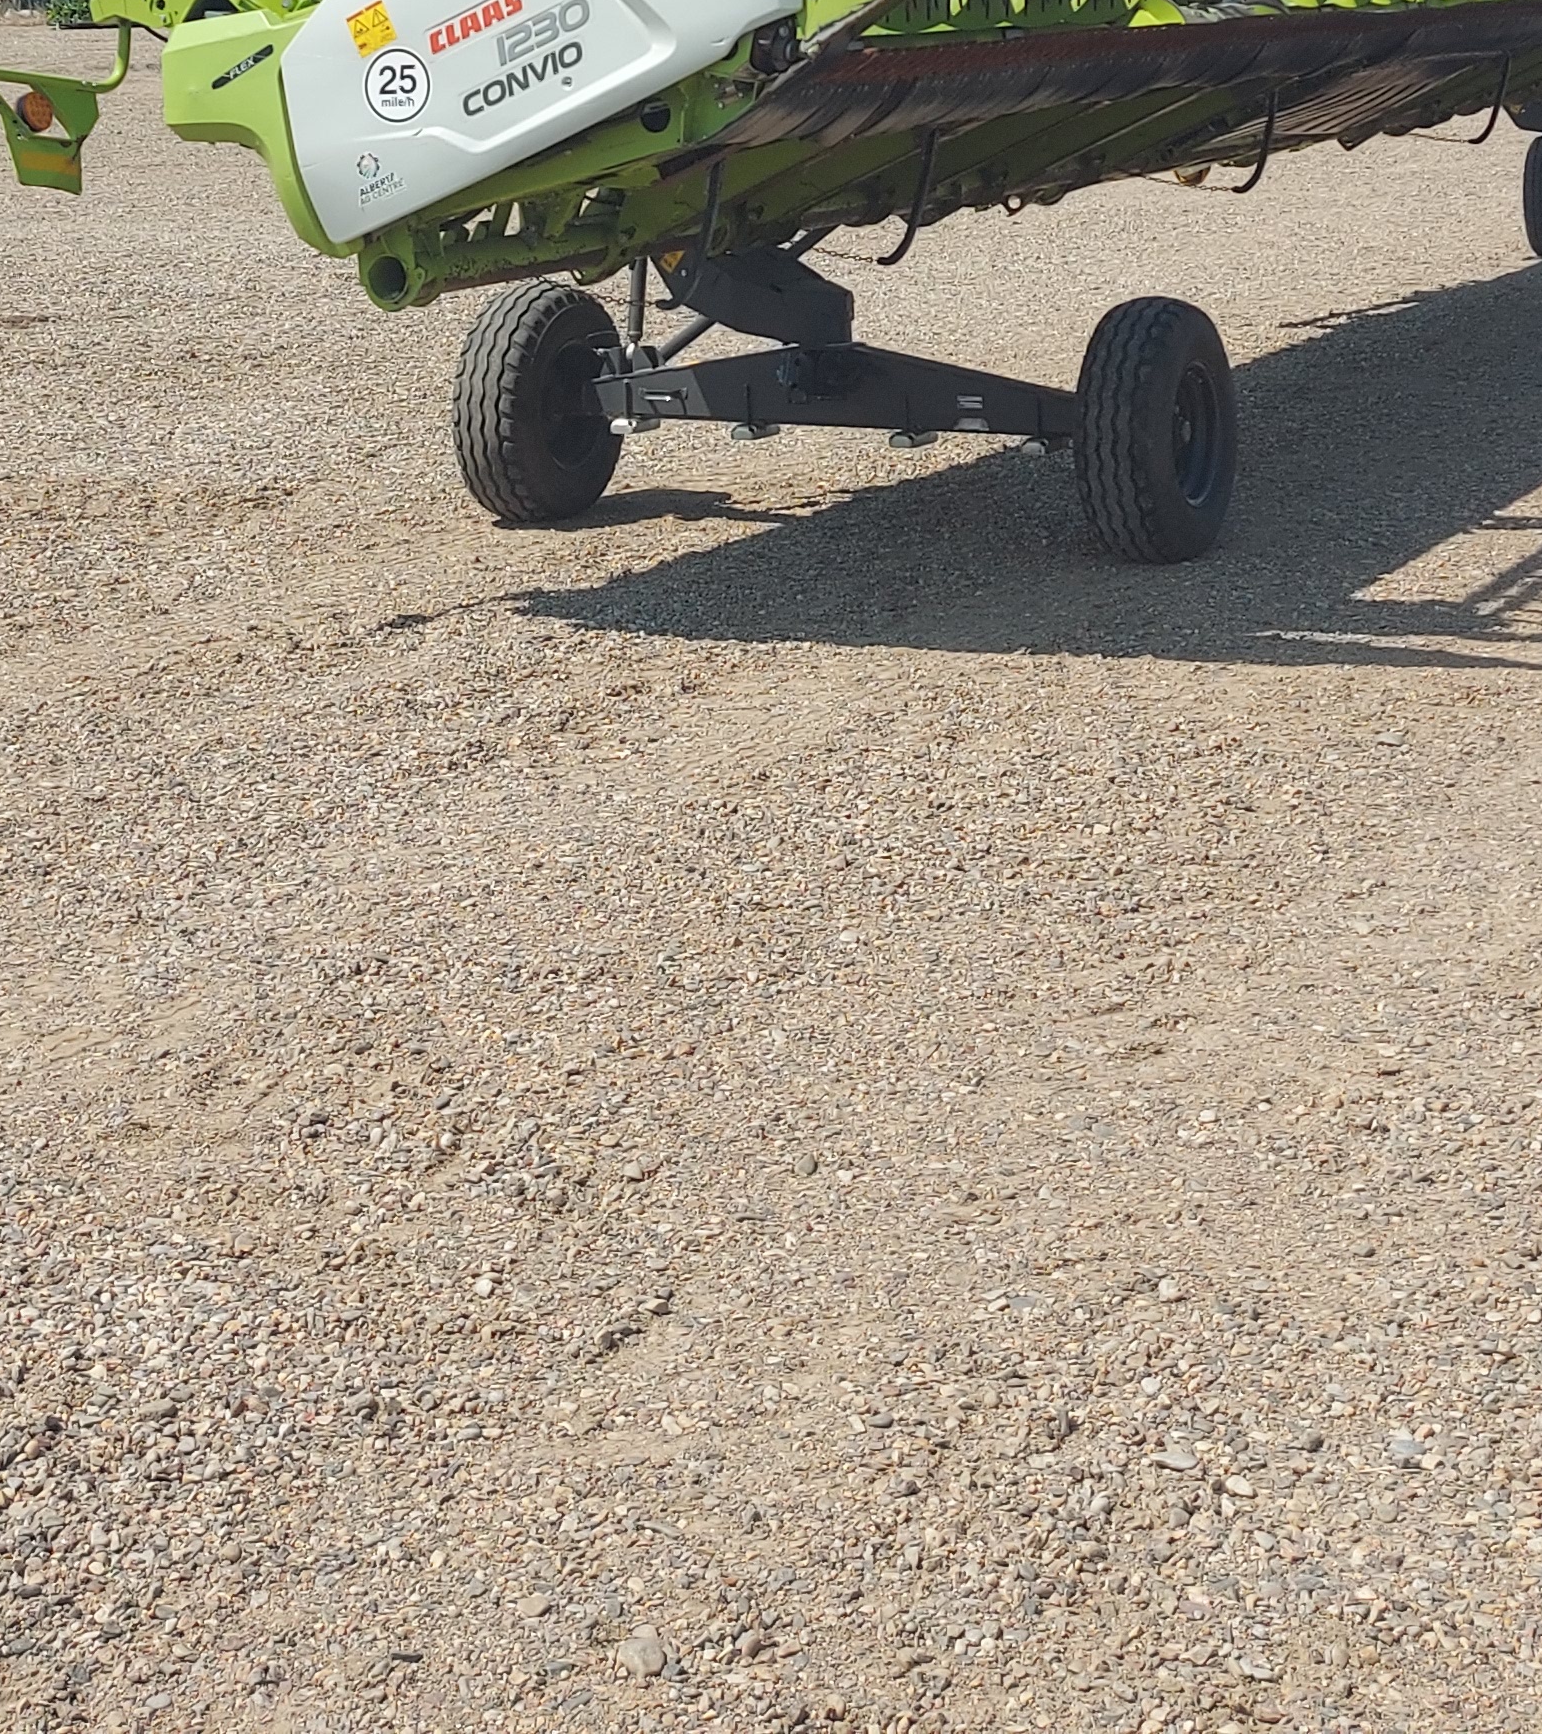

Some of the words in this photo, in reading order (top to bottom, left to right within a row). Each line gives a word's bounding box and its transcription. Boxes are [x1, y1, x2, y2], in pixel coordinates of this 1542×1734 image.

[229, 56, 255, 79] FLEX
[378, 64, 417, 95] 25
[463, 41, 583, 116] CONVIO
[381, 96, 415, 107] mile/h
